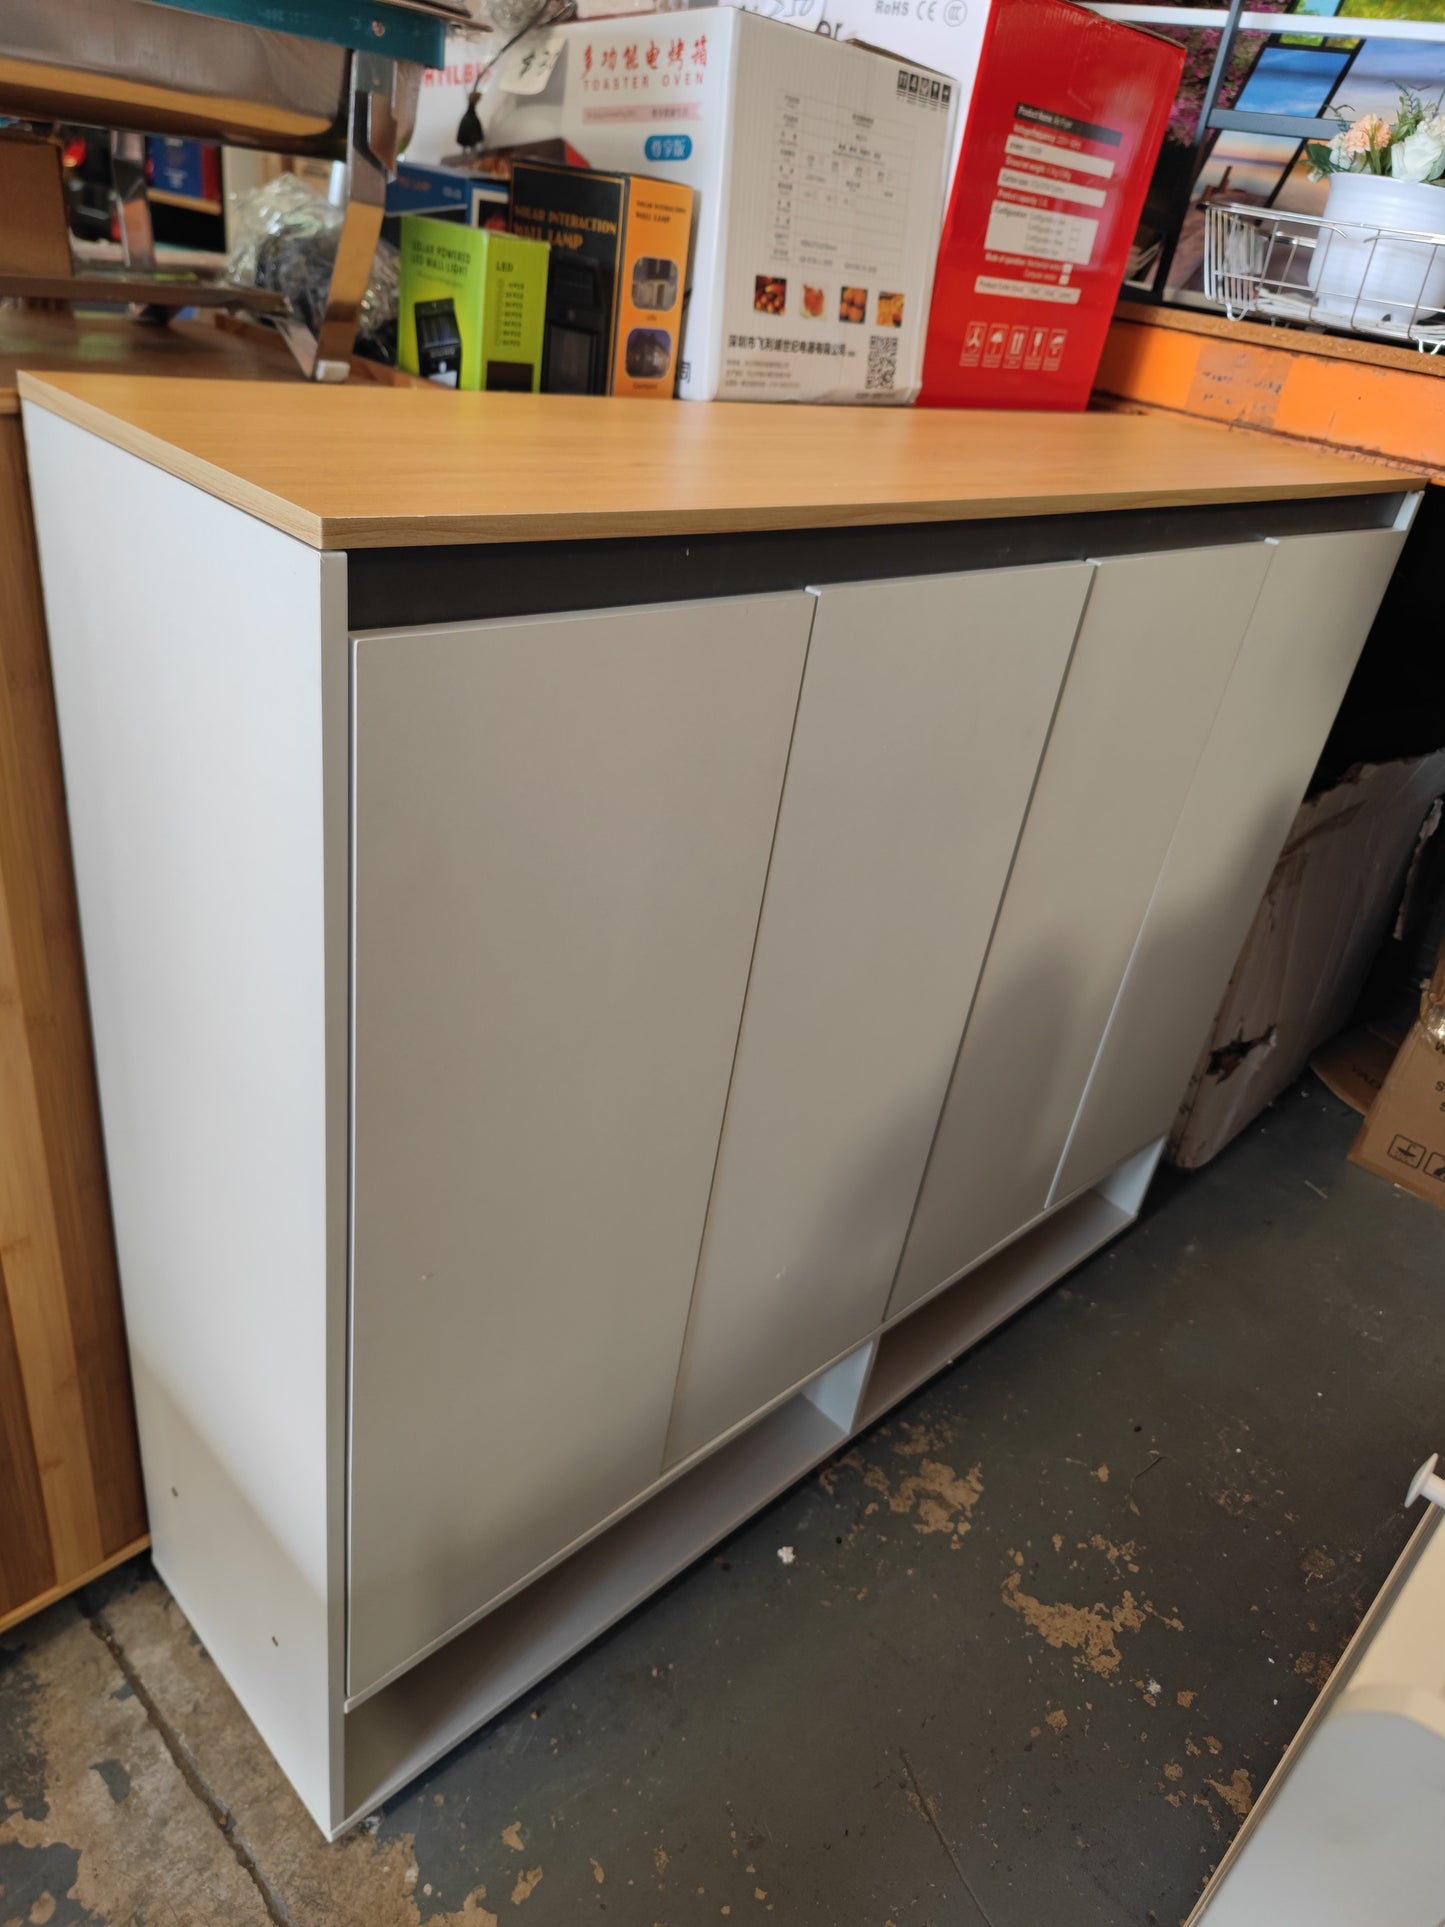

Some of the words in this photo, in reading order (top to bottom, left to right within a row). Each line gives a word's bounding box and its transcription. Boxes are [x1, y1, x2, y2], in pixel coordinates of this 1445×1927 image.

[875, 1, 909, 16] RoHS
[582, 34, 708, 79] 多功能电烤箱
[583, 74, 650, 92] TOASTER
[662, 72, 704, 88] OVEN
[549, 210, 617, 235] INTERACTION
[548, 229, 584, 250] LAMP
[496, 261, 514, 273] LED
